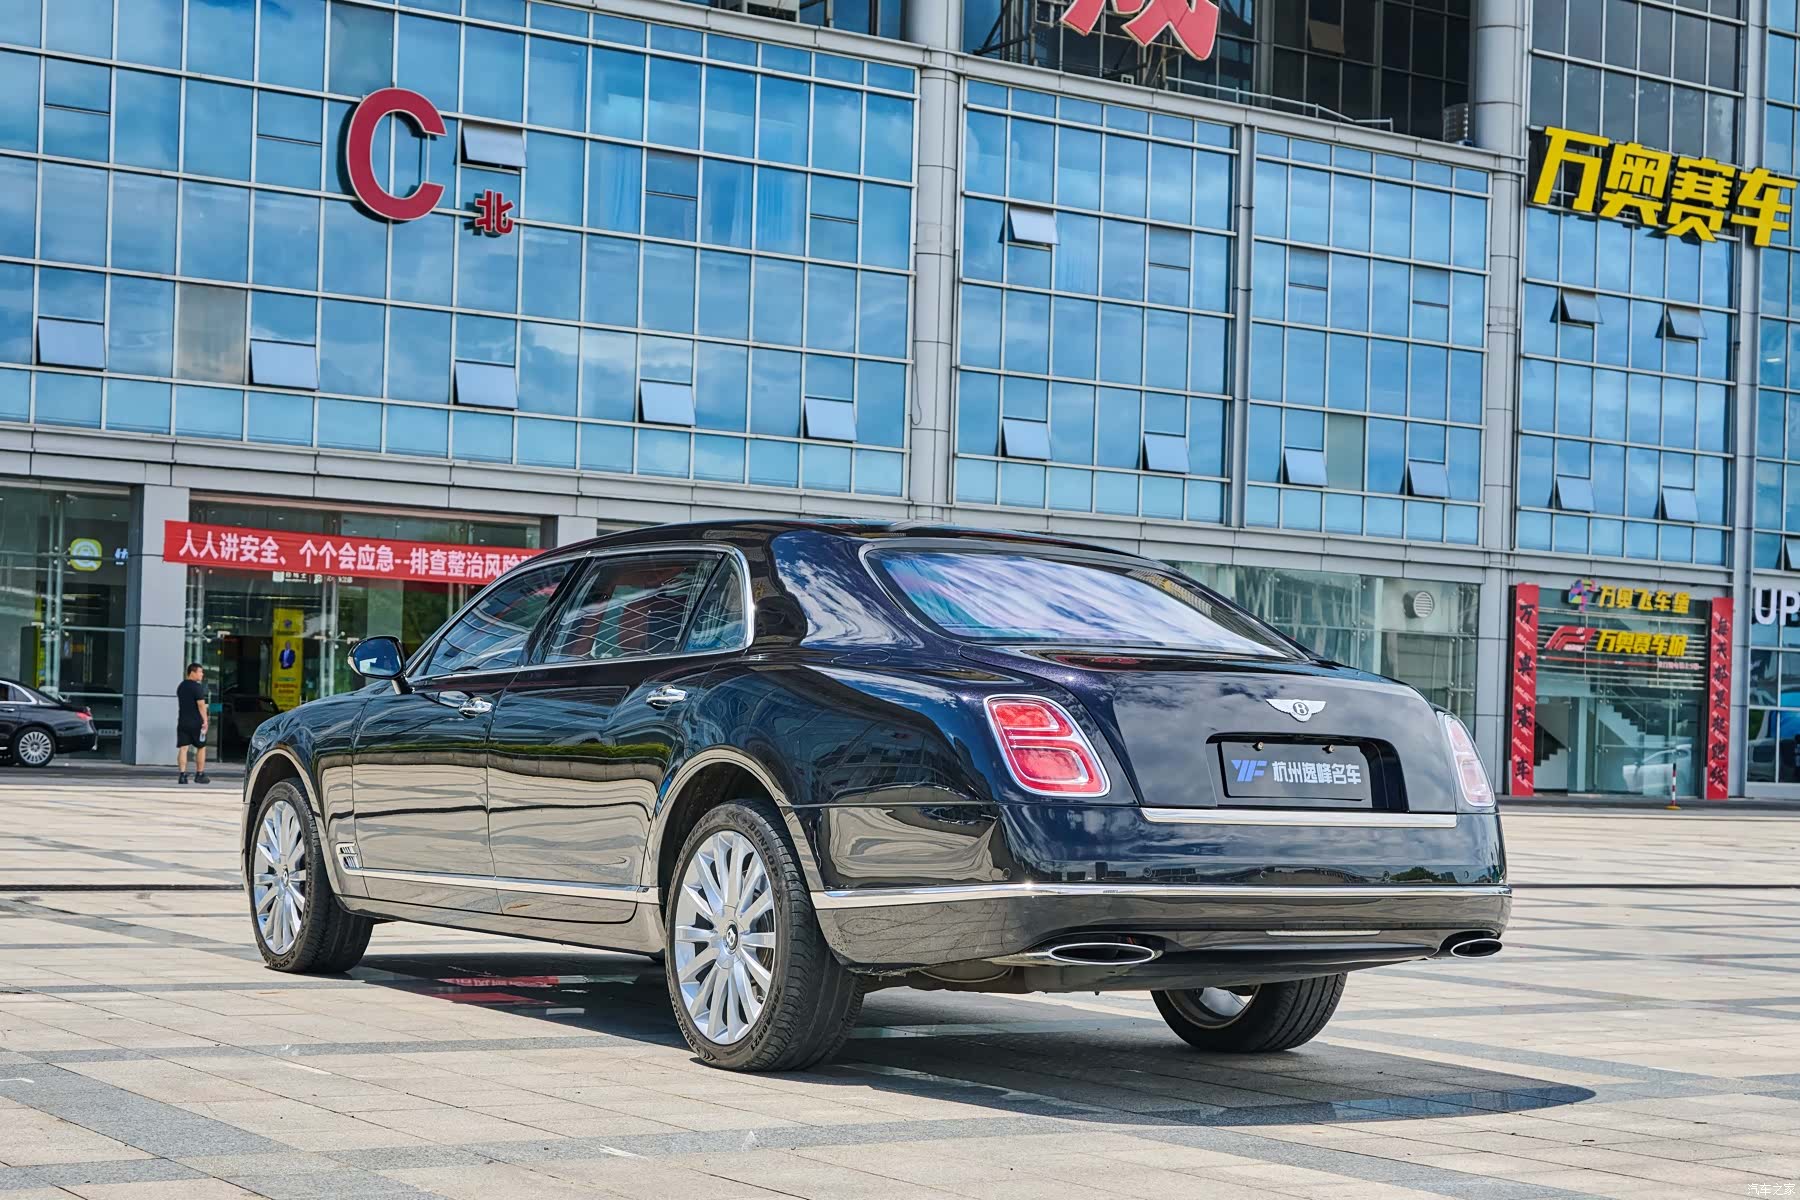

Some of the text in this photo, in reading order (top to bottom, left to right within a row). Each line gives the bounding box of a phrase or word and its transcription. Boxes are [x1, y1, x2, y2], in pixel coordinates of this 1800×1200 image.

[346, 87, 448, 221] C
[474, 189, 515, 235] 北
[1533, 126, 1798, 247] 万奥赛车
[178, 529, 533, 579] 人人讲安全、个个会应急--排查整治风险
[1272, 760, 1362, 785] 杭州逸峰名车
[747, 822, 780, 878] DUNLOP
